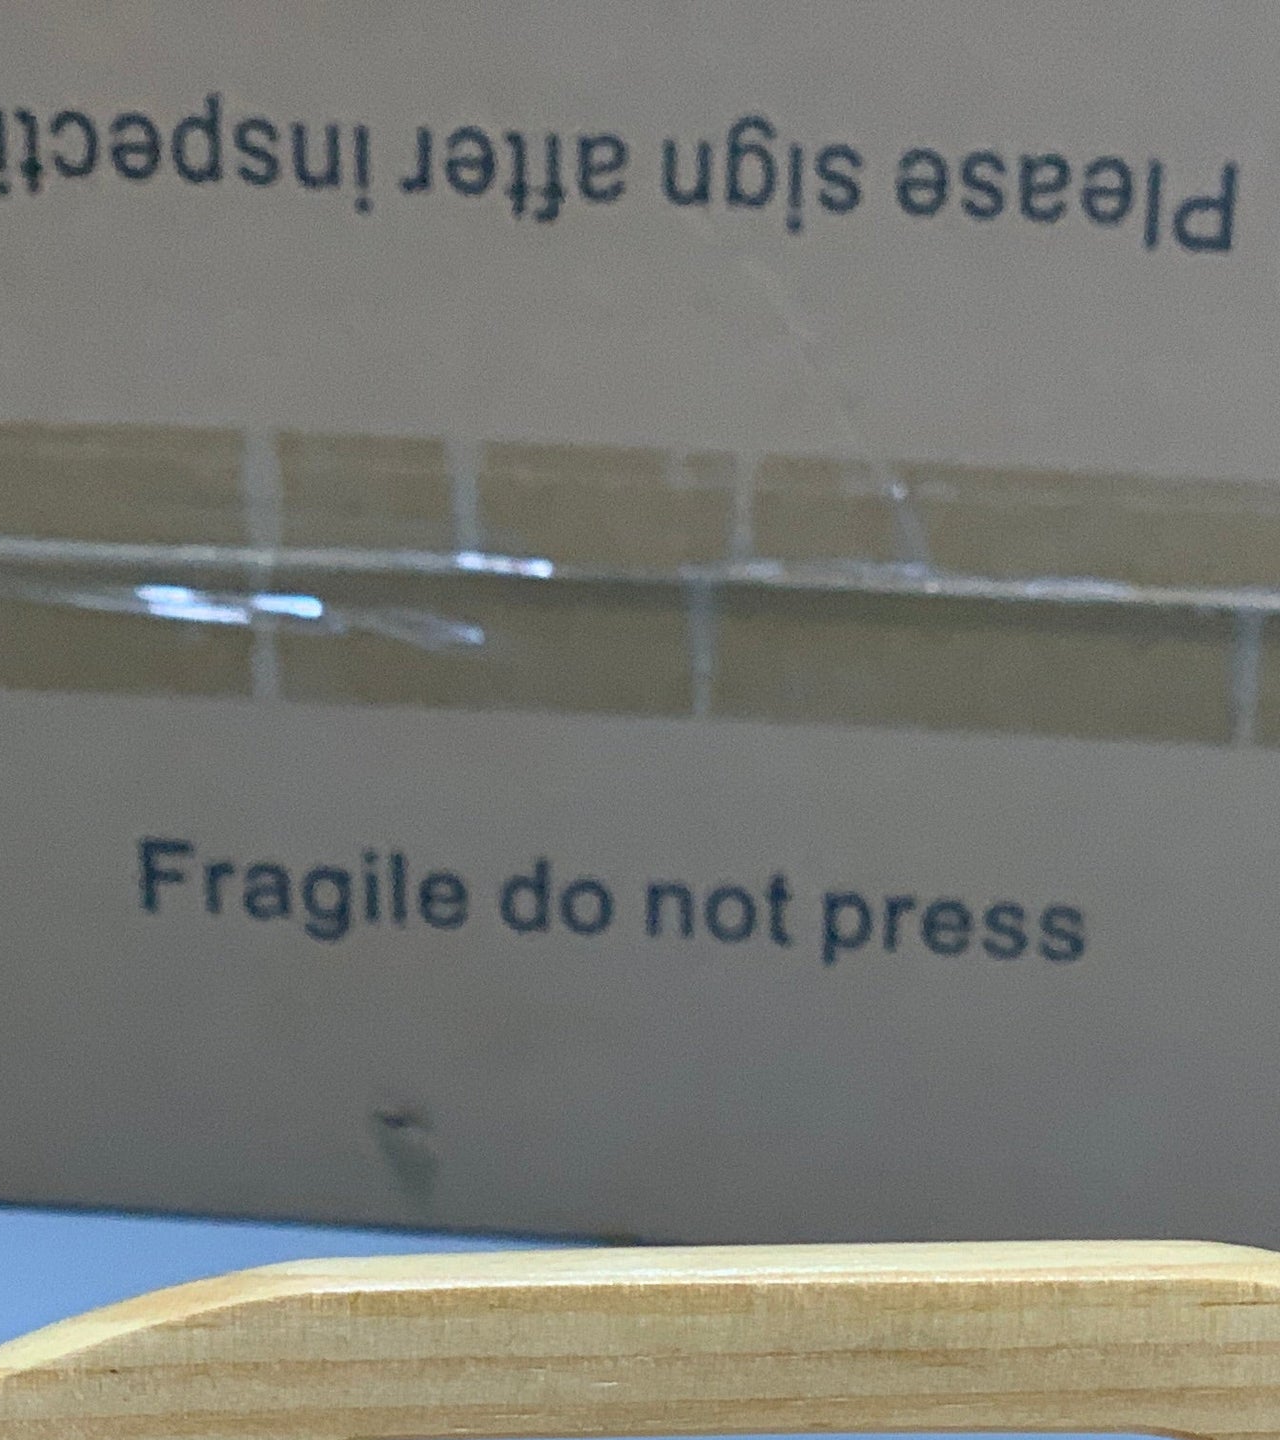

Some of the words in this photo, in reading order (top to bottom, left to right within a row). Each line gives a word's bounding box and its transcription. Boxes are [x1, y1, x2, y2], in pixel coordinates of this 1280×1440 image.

[397, 115, 630, 224] after
[656, 128, 864, 236] sign
[895, 143, 1241, 254] Please
[138, 837, 472, 942] Fragile
[499, 857, 615, 938] do
[644, 873, 793, 947] not
[821, 889, 1086, 966] press
